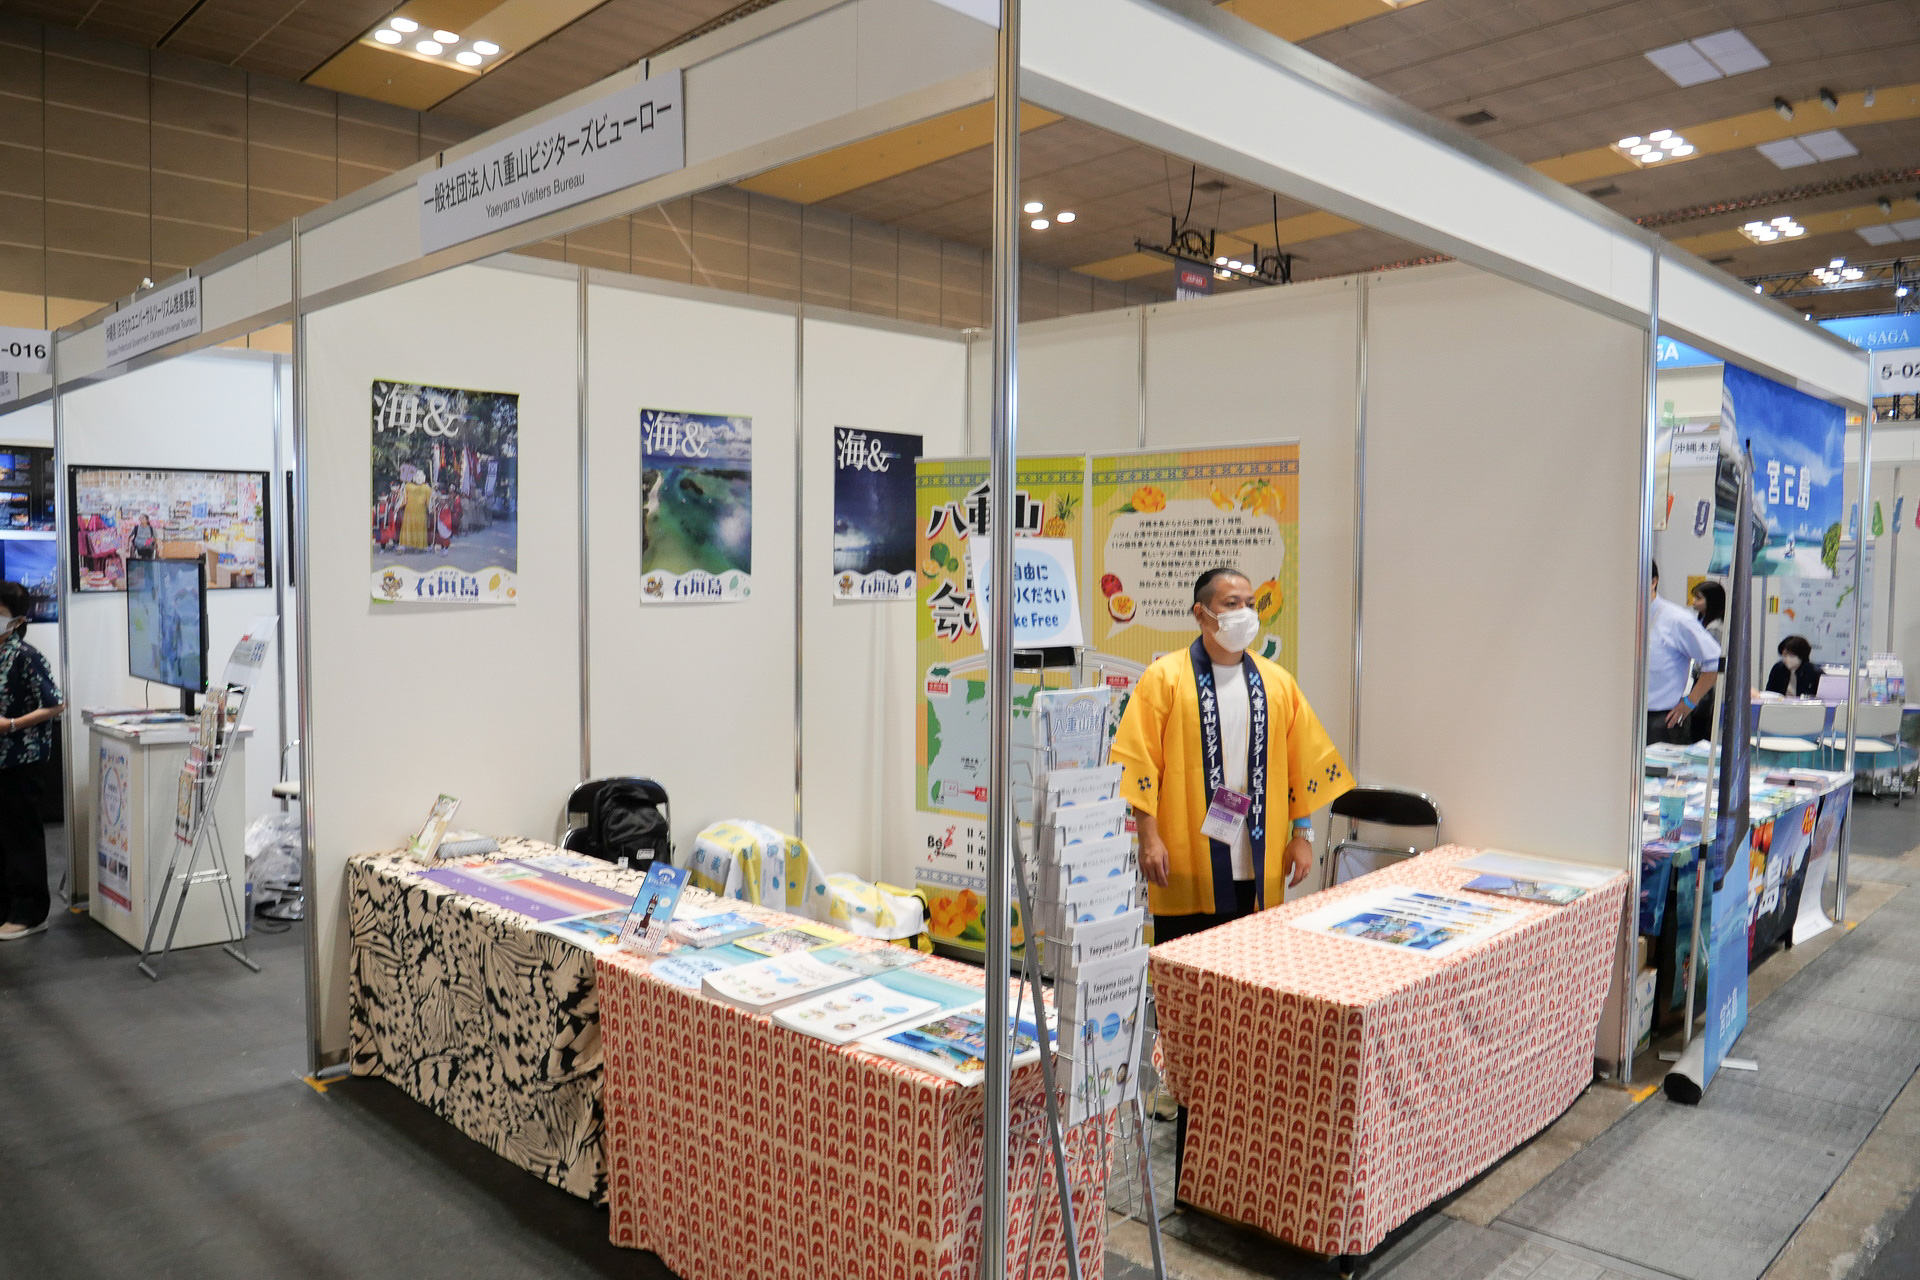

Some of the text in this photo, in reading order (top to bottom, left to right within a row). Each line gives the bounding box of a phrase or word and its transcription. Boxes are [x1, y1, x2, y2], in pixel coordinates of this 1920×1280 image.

[424, 100, 672, 213] 一般社団法人八重山ビジターズビューロー
[485, 194, 520, 219] Yaeyama
[553, 173, 585, 195] Bureau
[1867, 329, 1910, 346] SAGA
[1014, 561, 1049, 580] 自由に
[1014, 613, 1059, 627] ke Free
[1089, 936, 1129, 957] Yaeyama Islands
[1093, 974, 1134, 993] Yaeyama Islands
